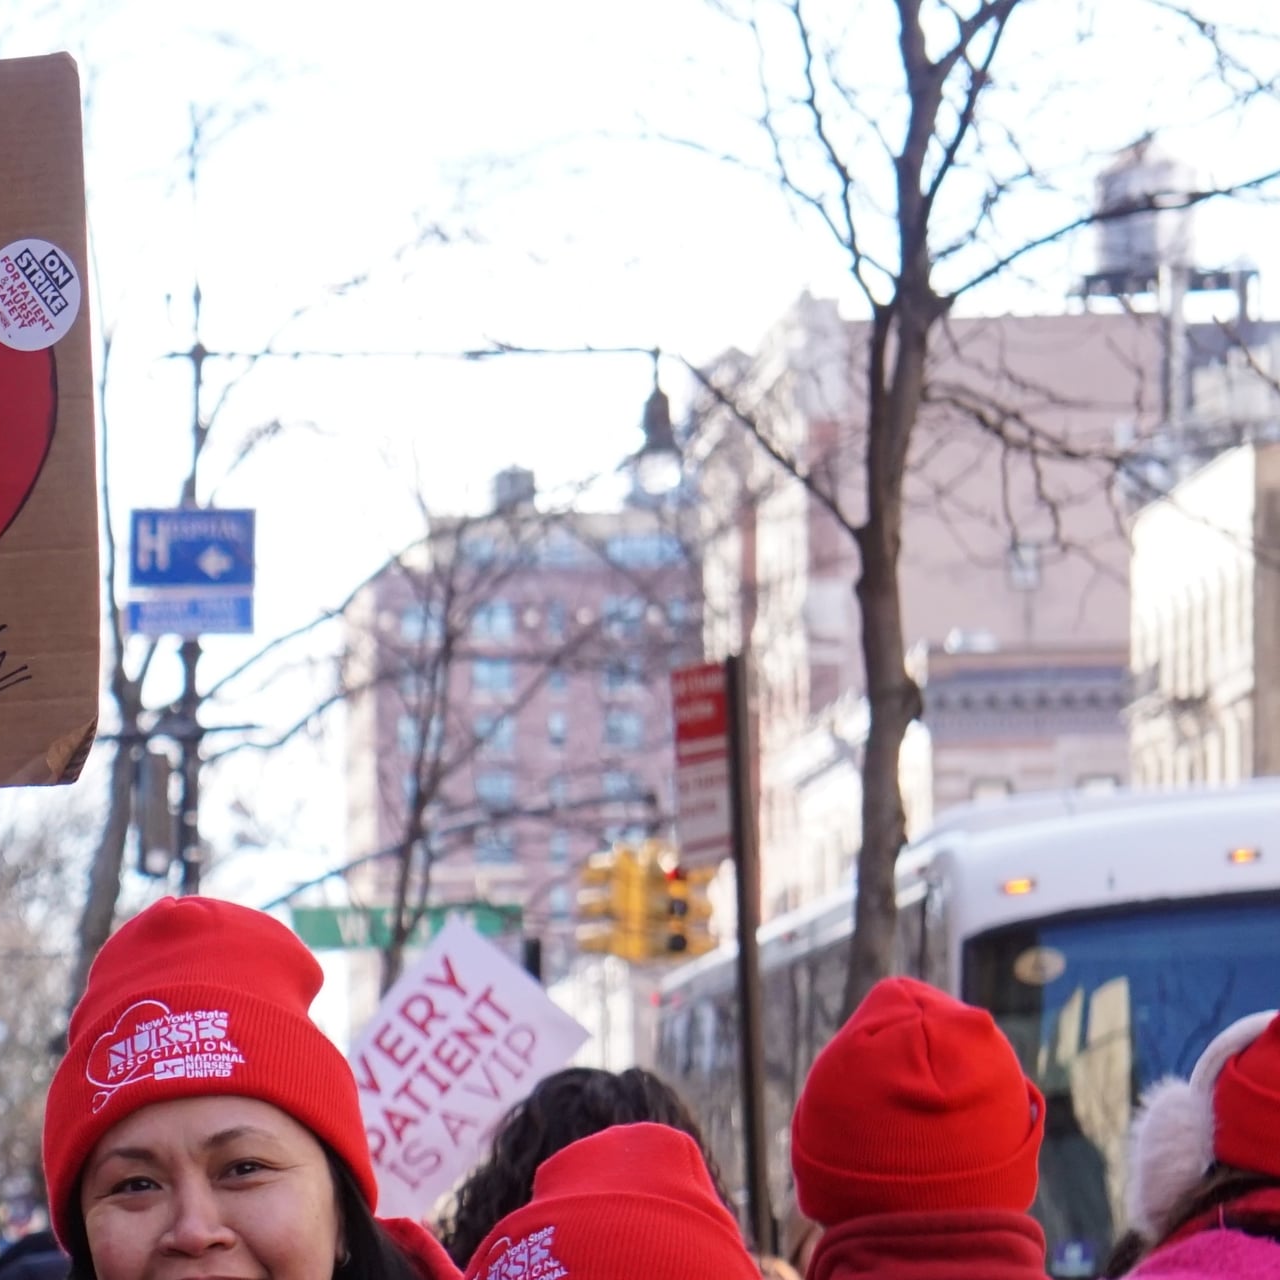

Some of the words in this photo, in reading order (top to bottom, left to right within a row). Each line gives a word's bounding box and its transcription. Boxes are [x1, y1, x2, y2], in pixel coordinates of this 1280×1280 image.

[16, 250, 66, 315] STRIKE
[42, 252, 71, 286] ON
[0, 255, 20, 282] FOR
[16, 280, 55, 333] PATIENT
[7, 284, 40, 328] NURSE
[164, 1013, 194, 1026] York
[194, 1009, 228, 1021] State
[358, 953, 469, 1096] VERY
[107, 1038, 233, 1081] ASSOCIATION
[108, 1018, 228, 1069] NURSES
[185, 1053, 246, 1065] NATIONAL
[187, 1069, 232, 1079] UNITED
[366, 985, 512, 1166] PATIENT
[386, 1137, 445, 1192] IS
[439, 1108, 480, 1147] A
[462, 1021, 539, 1103] VIP
